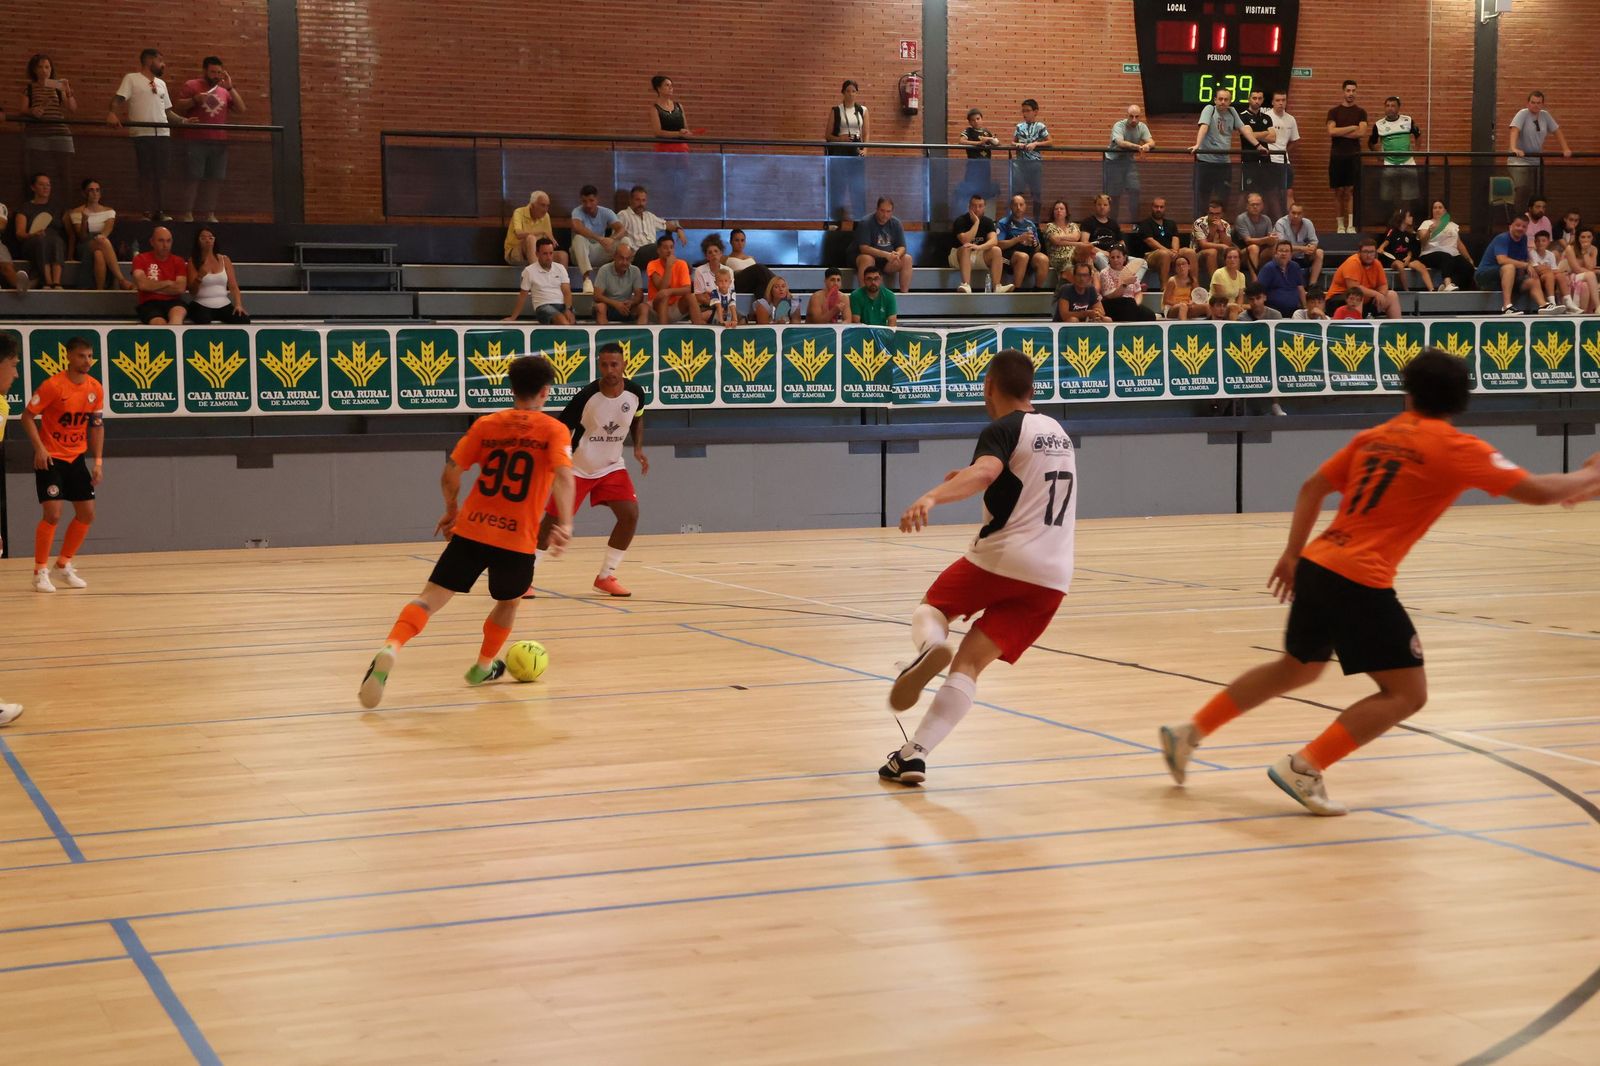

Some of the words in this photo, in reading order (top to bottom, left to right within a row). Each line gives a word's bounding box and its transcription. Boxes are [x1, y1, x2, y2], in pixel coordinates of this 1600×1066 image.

[1167, 4, 1187, 12] LOCAL
[1245, 6, 1276, 15] VISITANTE
[1207, 54, 1232, 62] PERIODO
[1198, 74, 1254, 104] 6:39
[188, 392, 212, 400] CAJA
[260, 391, 284, 399] CAJA
[331, 391, 354, 399] CAJA
[401, 390, 423, 398] CAJA
[478, 449, 534, 502] 99
[1346, 456, 1403, 516] 11
[1044, 470, 1074, 526] 17
[468, 510, 518, 532] uvesa
